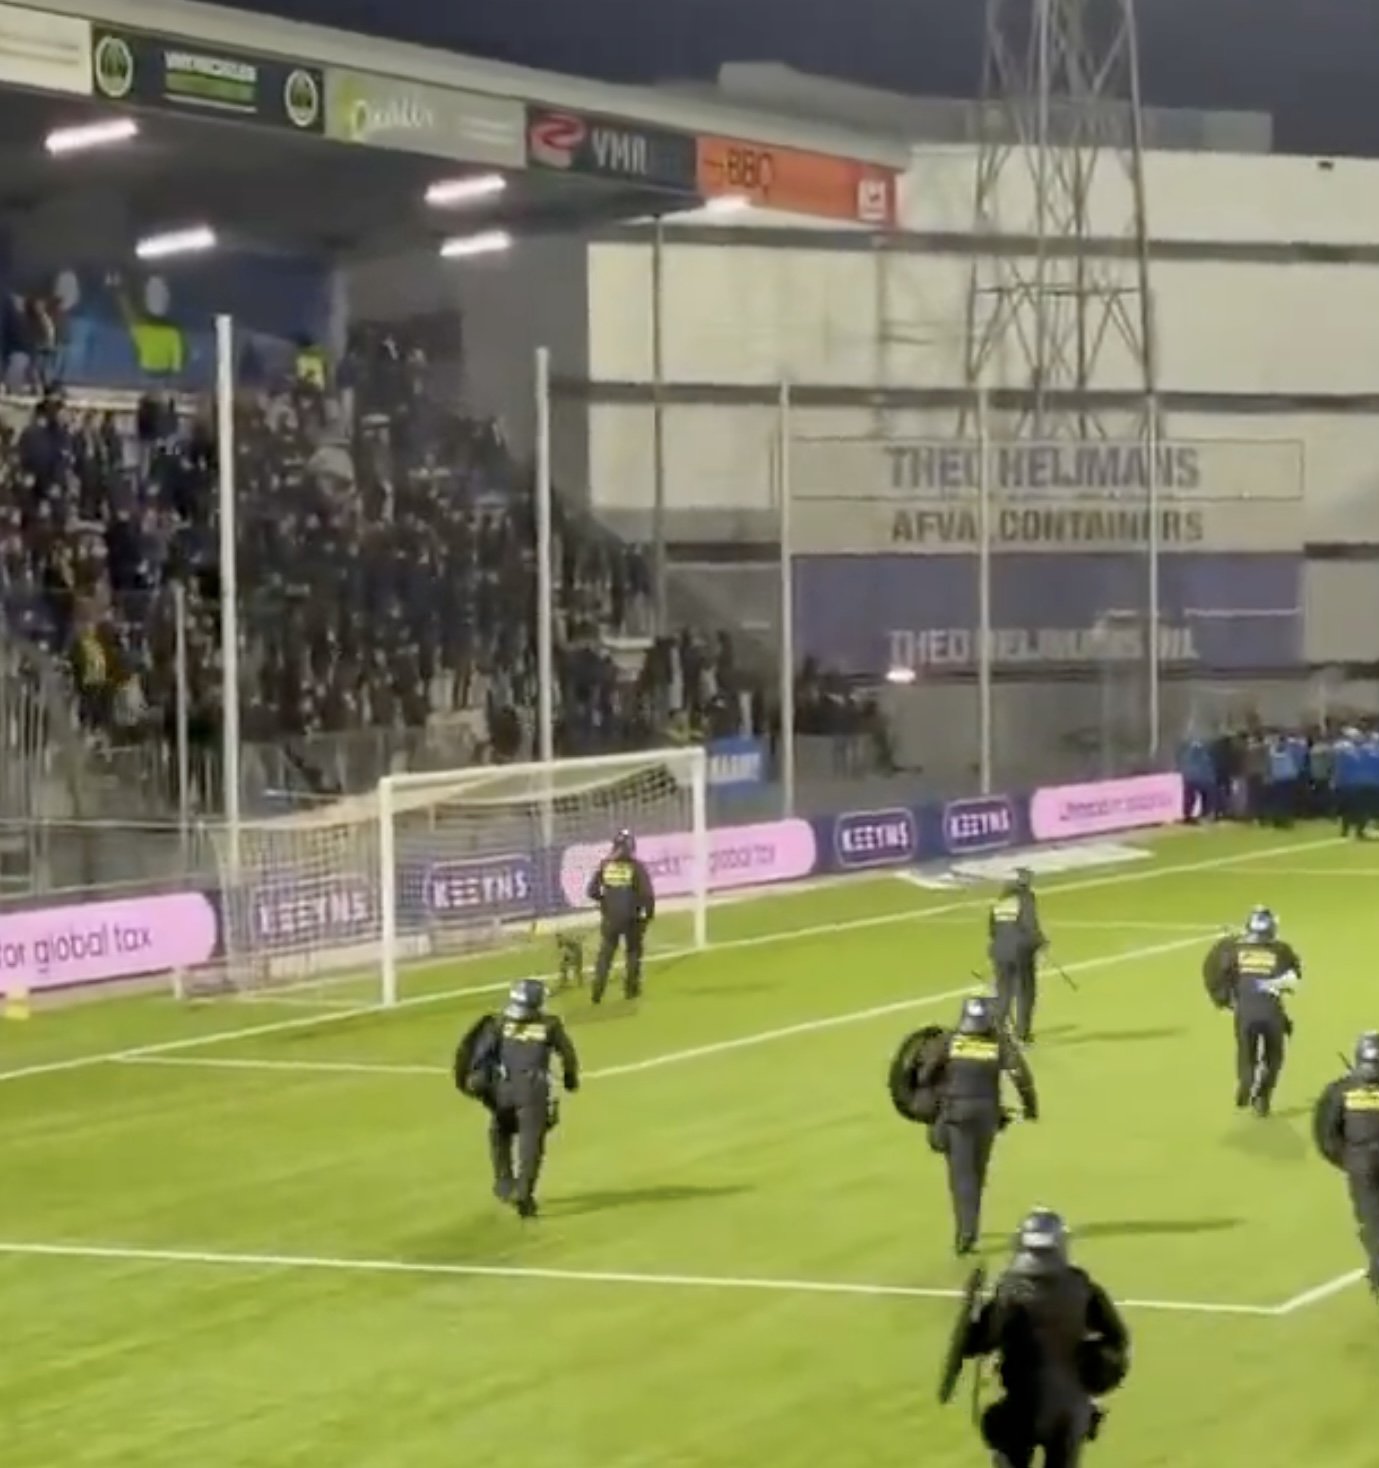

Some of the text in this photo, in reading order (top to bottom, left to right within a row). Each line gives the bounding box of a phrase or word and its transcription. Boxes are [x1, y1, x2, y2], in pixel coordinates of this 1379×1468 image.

[892, 508, 1204, 542] AFVACONTAINRS
[434, 869, 527, 908] KEEYNS
[34, 922, 108, 973] global
[114, 922, 154, 953] tax
